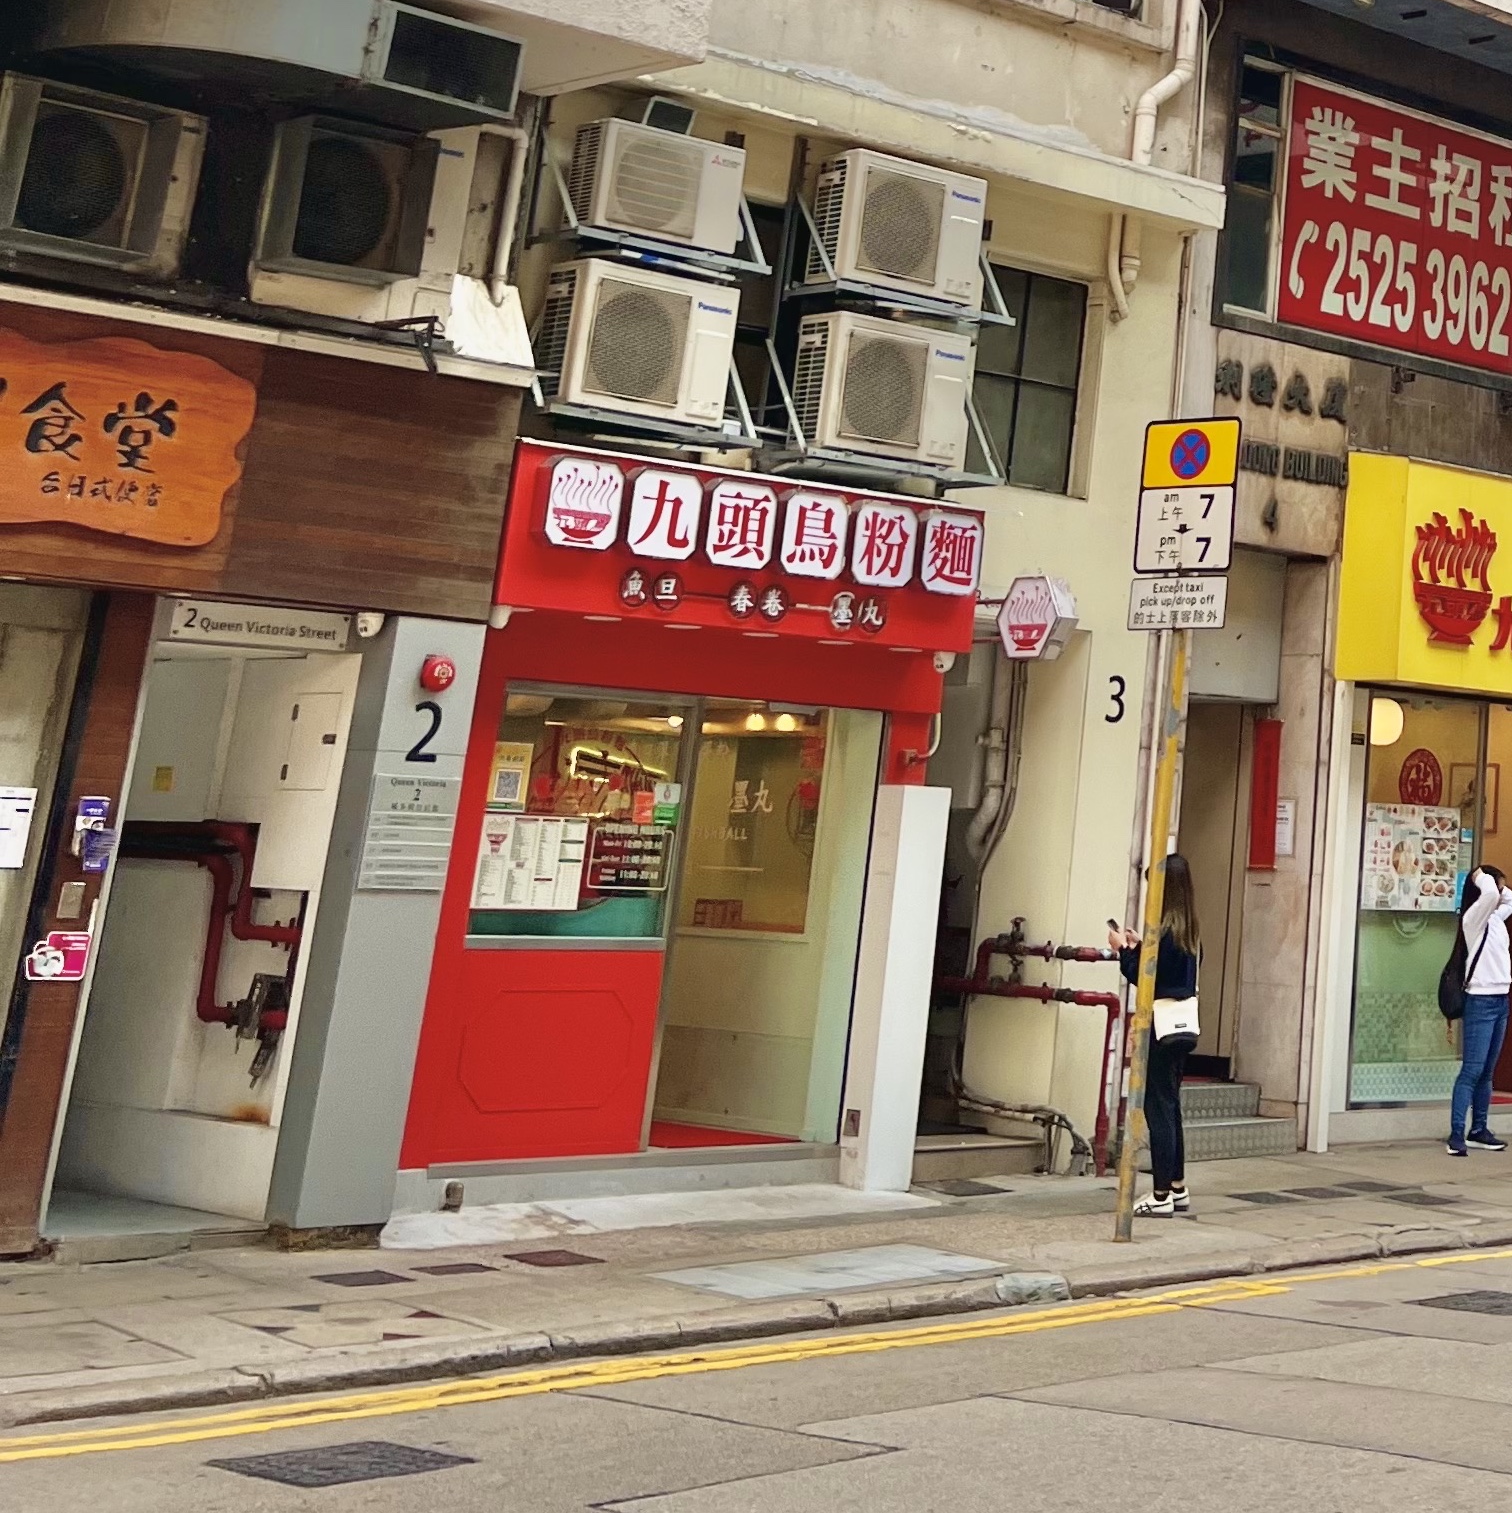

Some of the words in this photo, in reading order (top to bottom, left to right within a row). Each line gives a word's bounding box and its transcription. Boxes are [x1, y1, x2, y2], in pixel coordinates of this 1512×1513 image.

[952, 190, 981, 204] Panasonic
[1319, 221, 1418, 333] 2525
[1422, 251, 1511, 357] 3962
[698, 301, 733, 316] Panasonic
[935, 349, 965, 362] Panasonic
[0, 377, 179, 474] 食堂
[1282, 446, 1348, 489] BUILDING
[1157, 506, 1183, 521] 上午
[1200, 494, 1215, 519] 7
[1164, 493, 1179, 503] am
[642, 479, 978, 587] 九頭鳥粉麵
[1160, 536, 1176, 548] pm
[1155, 550, 1179, 564] 下午
[1195, 537, 1212, 563] 7
[623, 575, 680, 603] 魚旦
[731, 585, 786, 617] 春卷
[832, 594, 885, 627] 墨丸
[1140, 597, 1158, 609] pick
[1160, 596, 1197, 609] up/drop
[1200, 594, 1215, 605] off
[1153, 583, 1183, 594] Except
[1185, 583, 1204, 593] taxi
[183, 609, 197, 629] 2
[200, 617, 243, 636] Queen
[246, 620, 296, 639] Victoria
[298, 626, 338, 642] Street
[1133, 609, 1218, 625] 的士上落客除外
[1105, 675, 1126, 723] 3
[405, 700, 443, 763] 2
